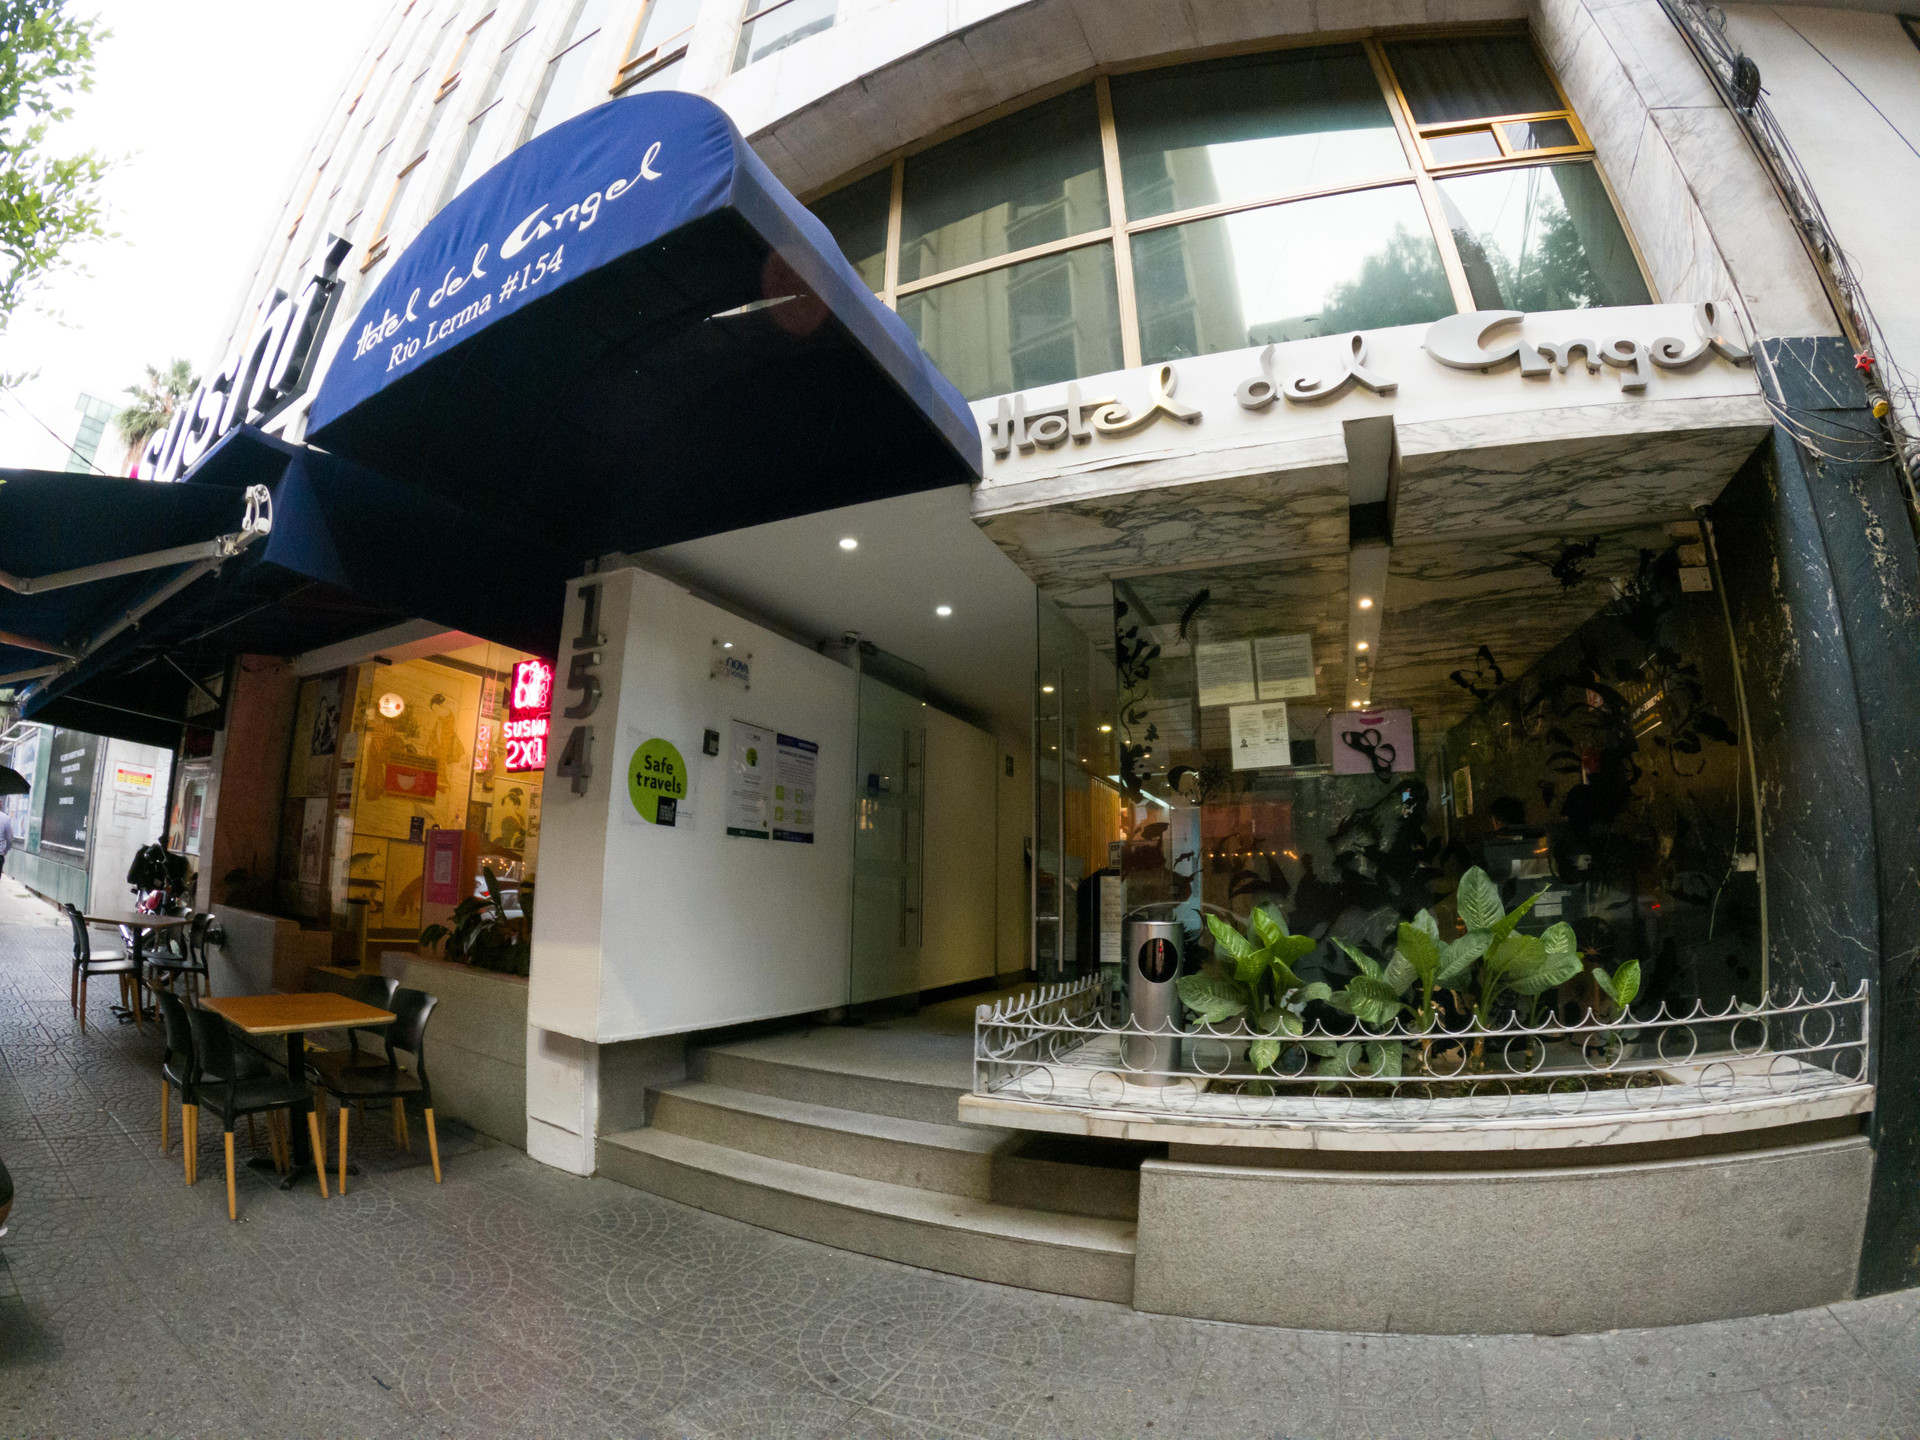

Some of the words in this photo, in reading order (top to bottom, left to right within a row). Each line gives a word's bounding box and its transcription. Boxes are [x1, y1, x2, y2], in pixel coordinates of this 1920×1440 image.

[352, 287, 421, 361] Hotel
[428, 243, 490, 309] del
[499, 141, 663, 260] Angel
[385, 331, 420, 372] Rio
[422, 293, 492, 350] Lerma
[498, 244, 565, 304] #154
[987, 365, 1204, 458] Hotel
[1234, 334, 1399, 411] del
[1421, 299, 1754, 392] Angel
[557, 582, 604, 796] 154
[636, 771, 683, 794] travels
[644, 754, 674, 775] Safe
